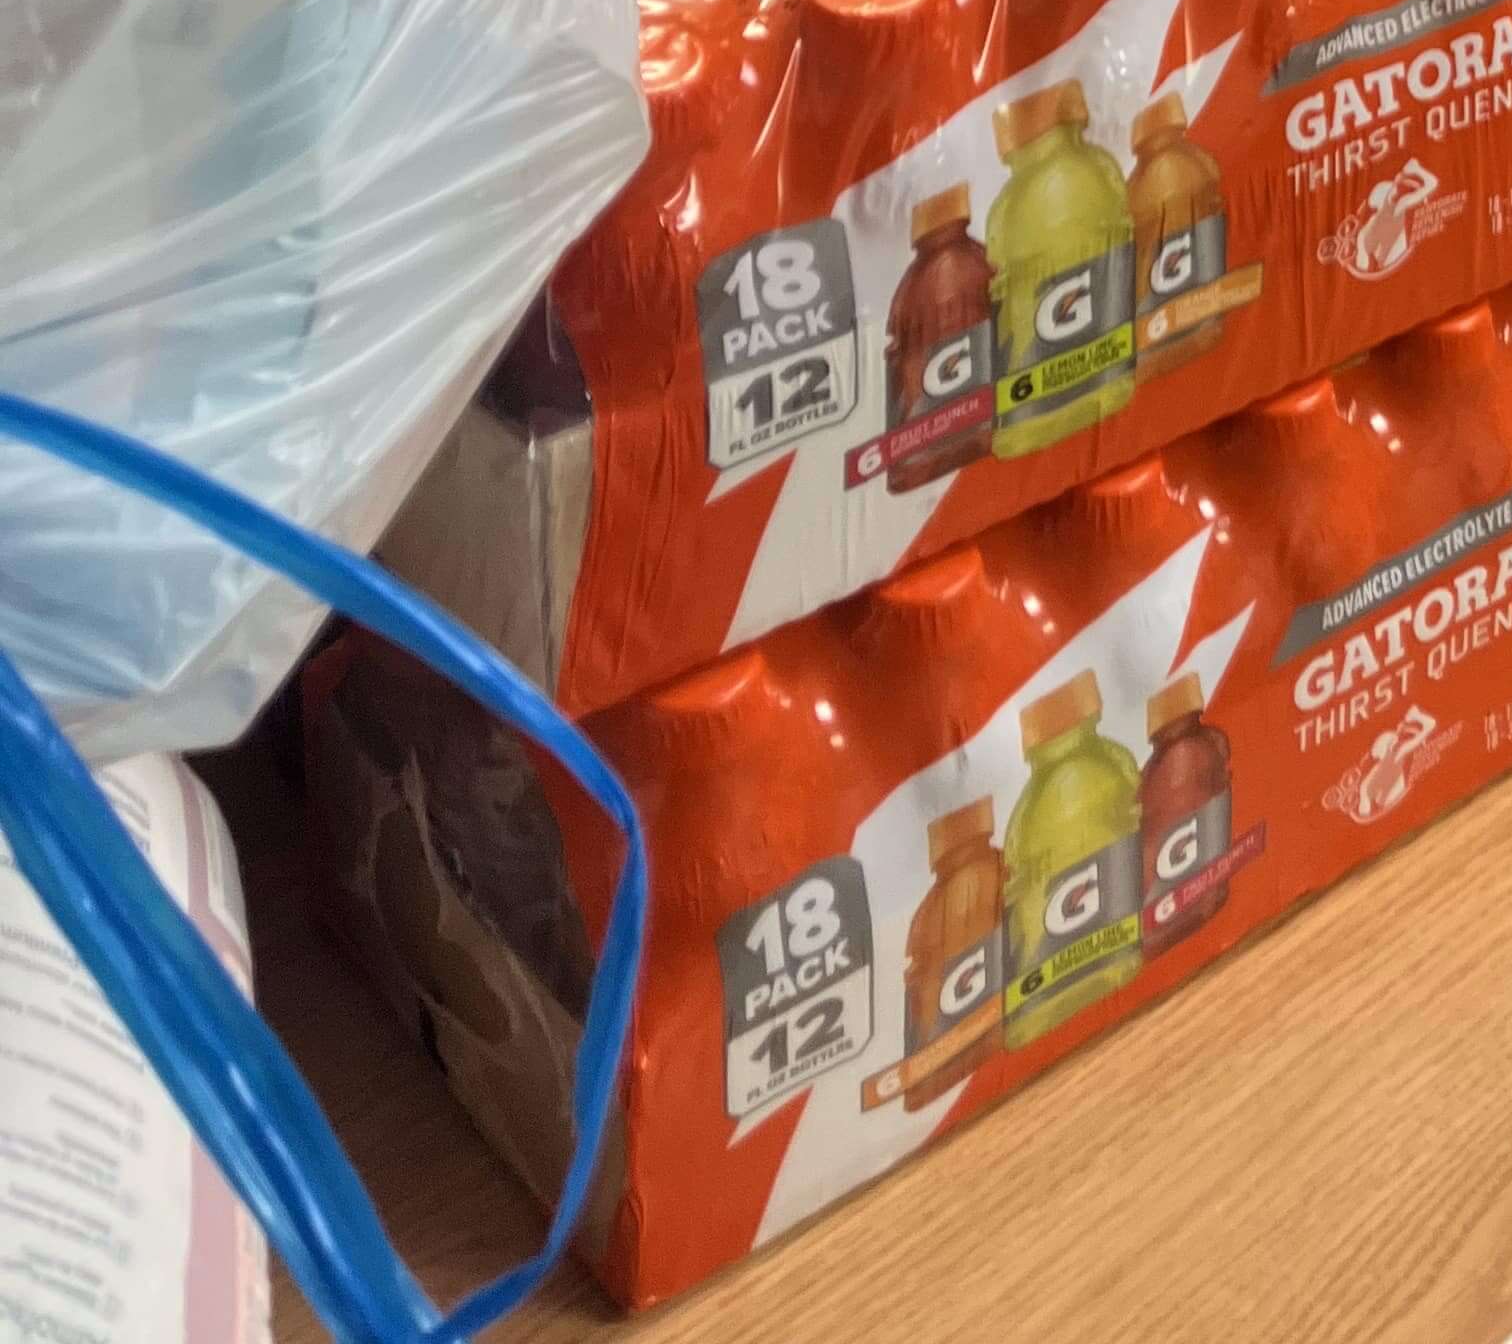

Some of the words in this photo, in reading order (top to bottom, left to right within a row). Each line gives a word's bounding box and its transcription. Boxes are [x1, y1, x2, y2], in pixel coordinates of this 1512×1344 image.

[1316, 14, 1399, 68] ADVANCED
[1287, 116, 1413, 195] THIRST
[722, 238, 822, 321] 18
[1150, 232, 1193, 296] G
[722, 300, 834, 366] PACK
[1035, 269, 1094, 342] G
[1147, 314, 1169, 340] 6
[734, 356, 833, 431] 12
[922, 335, 972, 398] G
[1009, 375, 1035, 403] 6
[729, 437, 747, 457] FL
[751, 428, 773, 449] OZ
[773, 401, 841, 441] BOTTLES
[857, 445, 883, 476] 6
[933, 395, 981, 432] PUNCH
[1321, 566, 1403, 631] ADVANCED
[1405, 505, 1512, 582] ELECTROLYTE
[1294, 662, 1415, 753] THIRST
[1155, 819, 1199, 881] G
[745, 876, 842, 976] 18
[1043, 864, 1101, 935] G
[1155, 894, 1177, 925] 6
[745, 942, 852, 1021] PACK
[939, 947, 987, 1016] G
[1019, 968, 1045, 997] 6
[748, 995, 847, 1074] 12
[786, 1038, 855, 1085] BOTTLES
